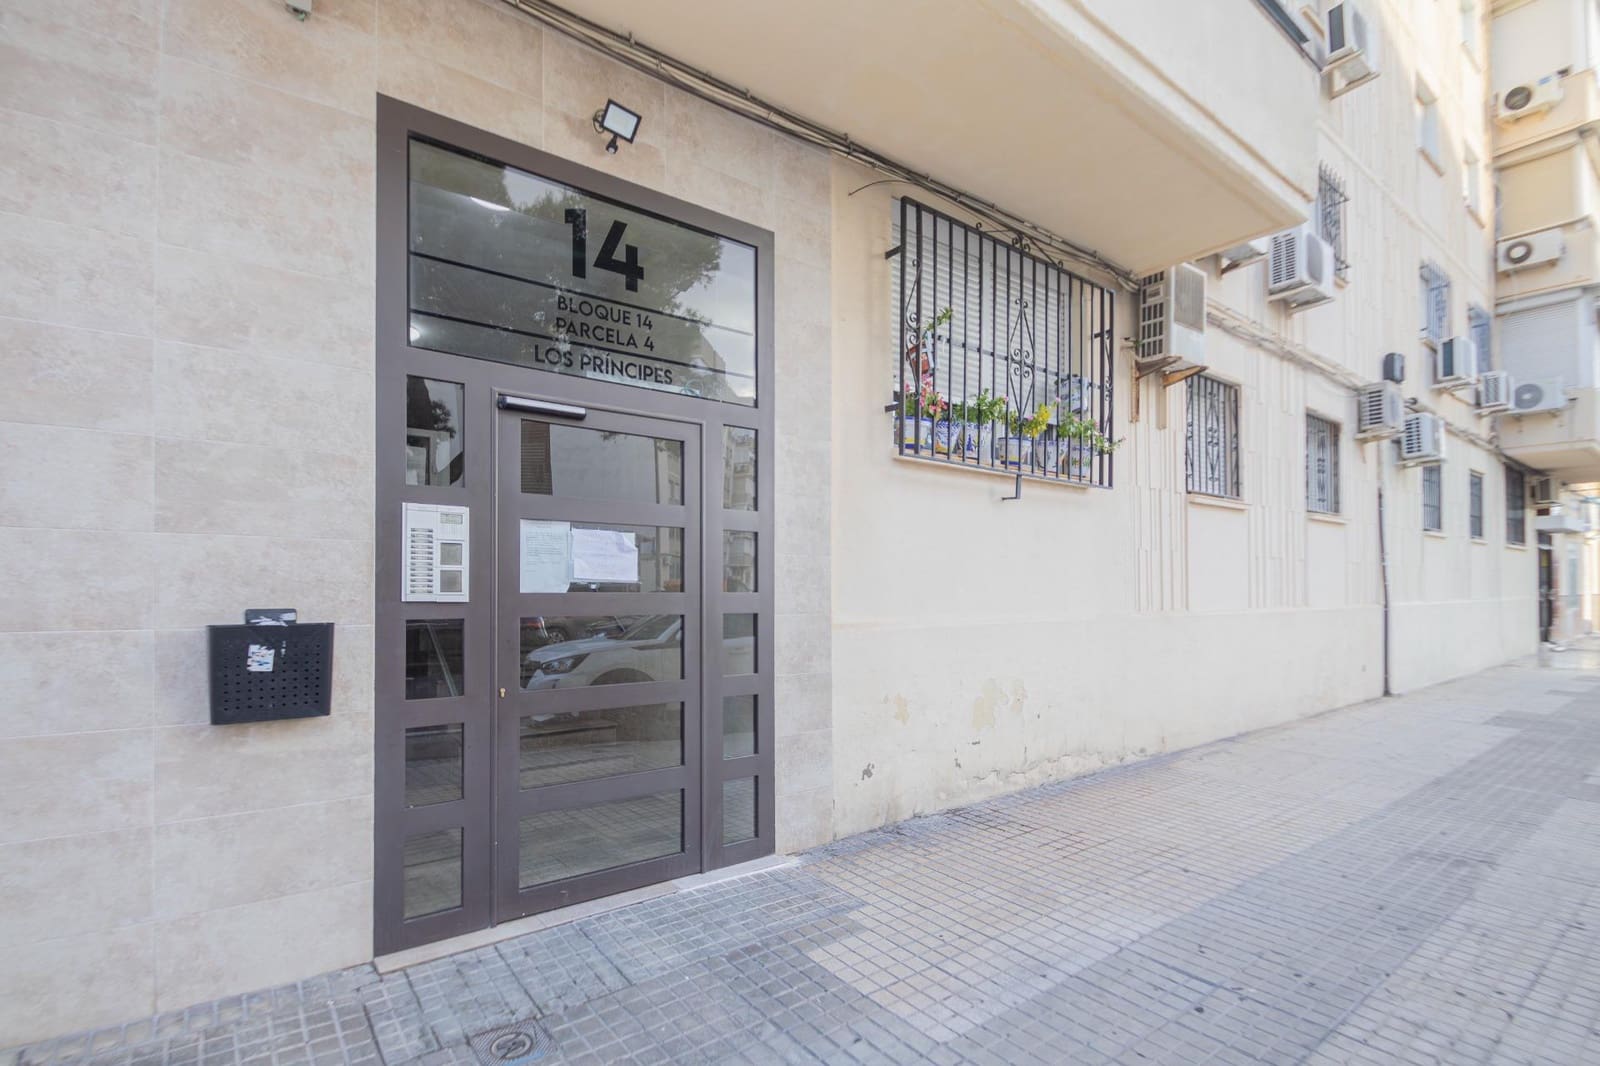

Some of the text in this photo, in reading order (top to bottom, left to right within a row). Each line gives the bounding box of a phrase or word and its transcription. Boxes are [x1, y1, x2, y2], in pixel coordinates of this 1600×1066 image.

[564, 209, 644, 292] 14
[557, 295, 653, 331] BLOQUE 14
[556, 317, 655, 351] PARCELA 4
[534, 345, 672, 384] LOS PRÍNCIPES
